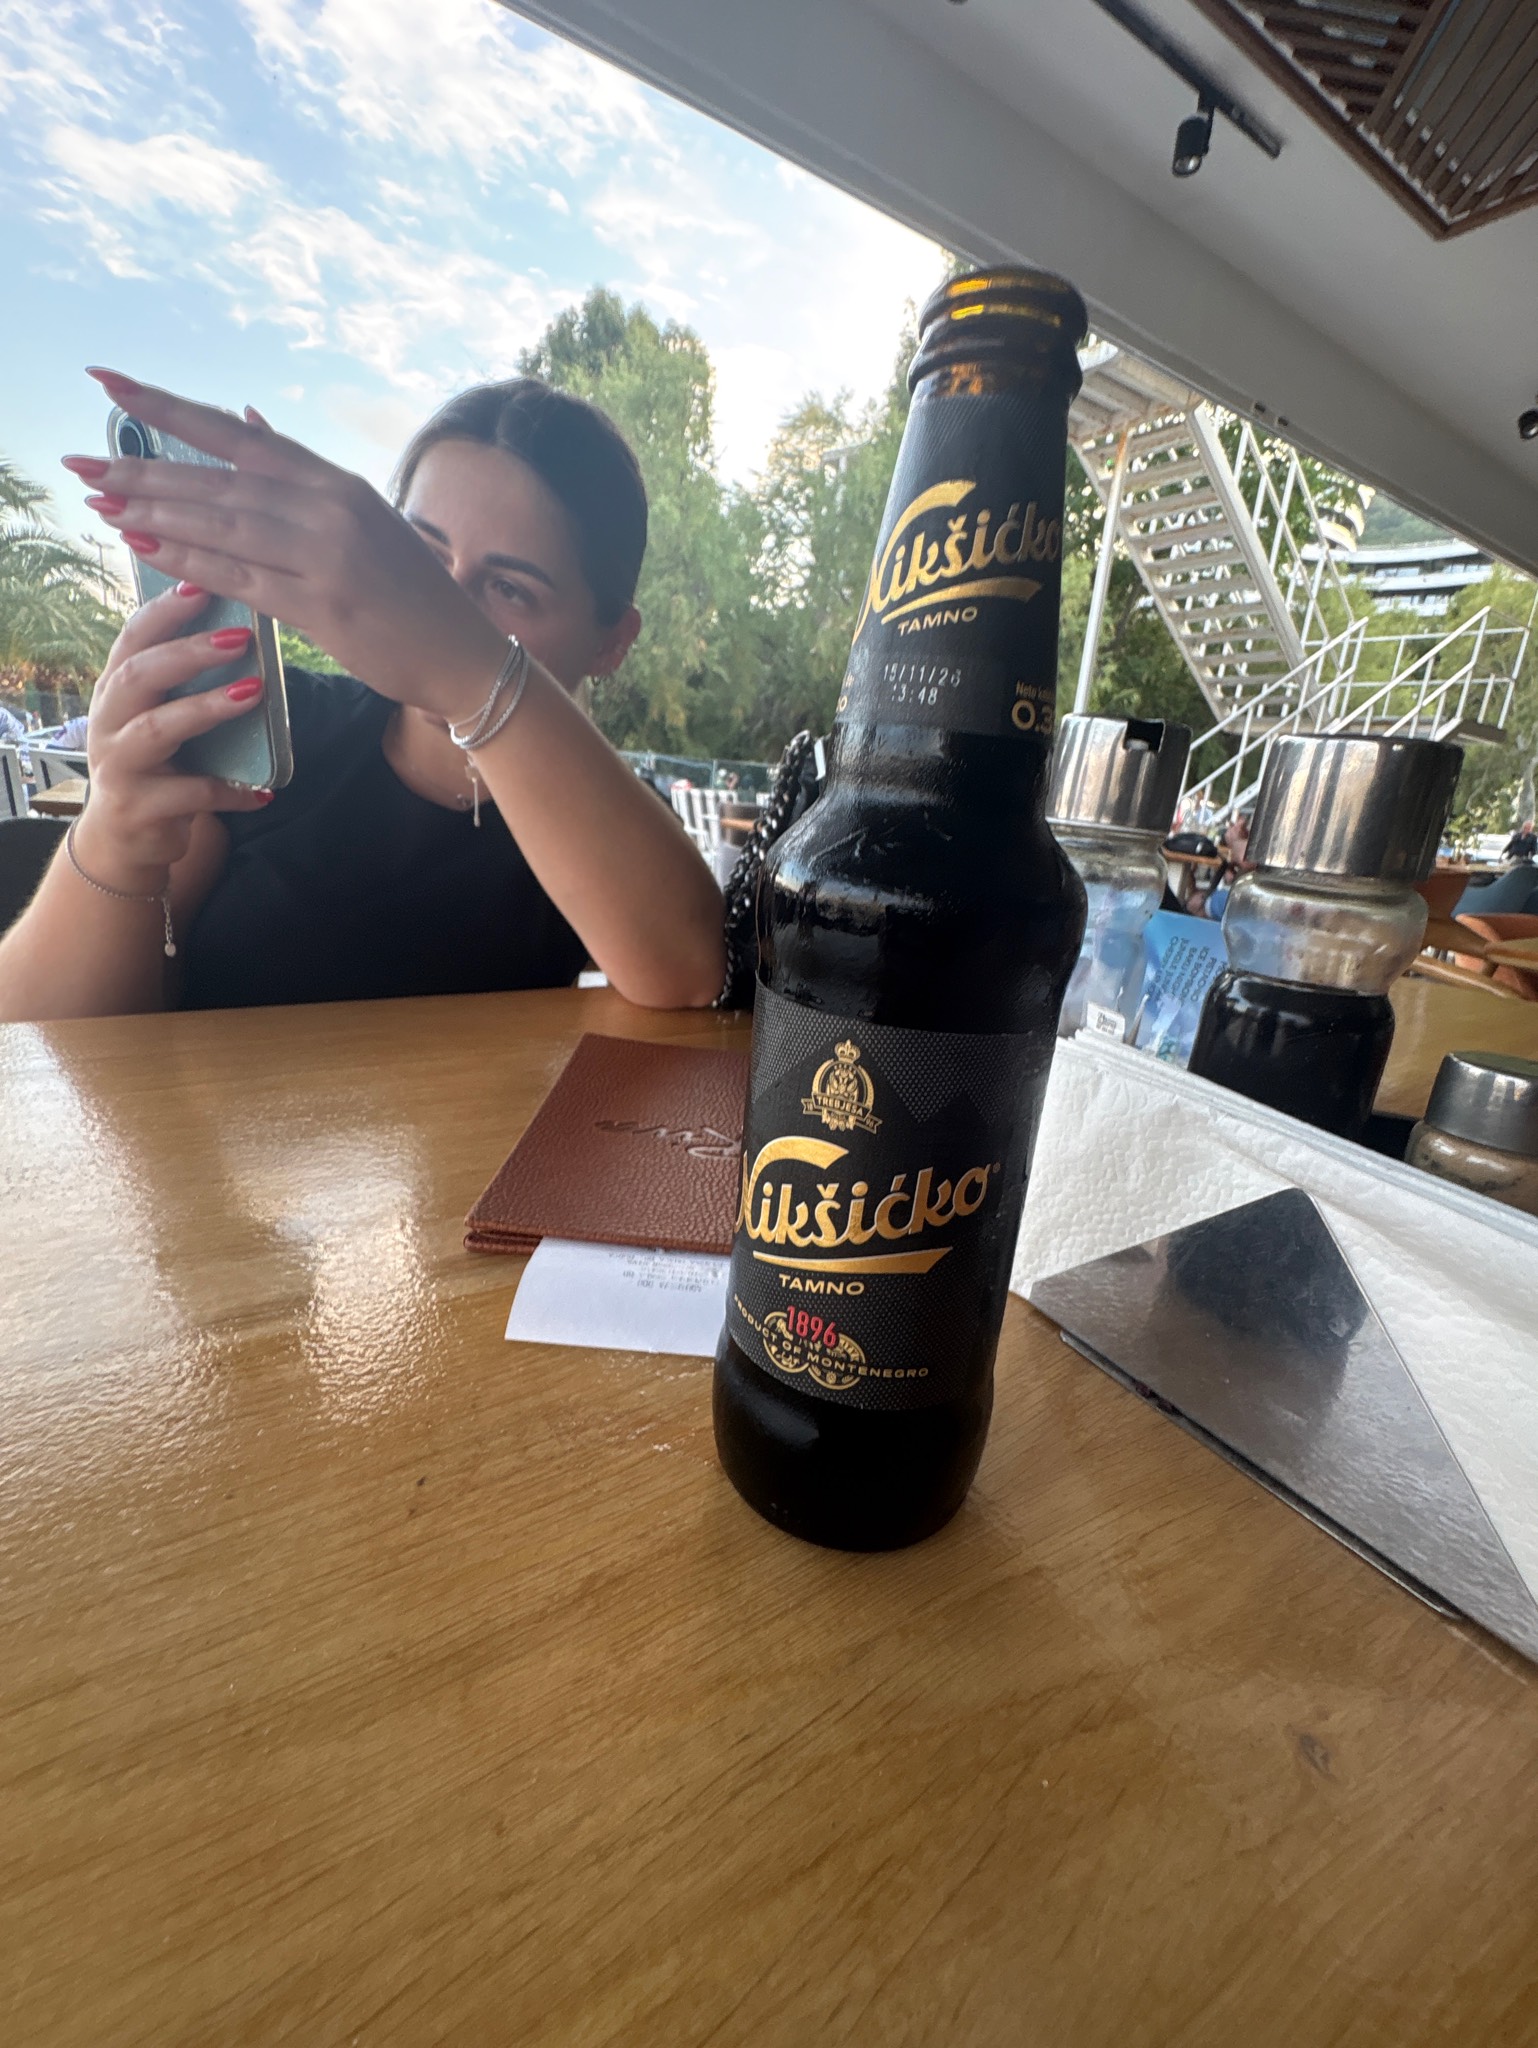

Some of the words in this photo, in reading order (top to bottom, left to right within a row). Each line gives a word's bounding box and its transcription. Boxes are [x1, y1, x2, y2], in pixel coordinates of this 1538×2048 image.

[897, 606, 978, 637] TAMNO
[816, 1096, 863, 1117] TREBJESA
[734, 1136, 992, 1248] Nikšićko
[778, 1273, 865, 1296] TAMNO
[734, 1293, 777, 1342] PRODUCT
[782, 1340, 802, 1354] OF
[807, 1351, 929, 1378] MONTENEGRO
[787, 1305, 838, 1348] 1896
